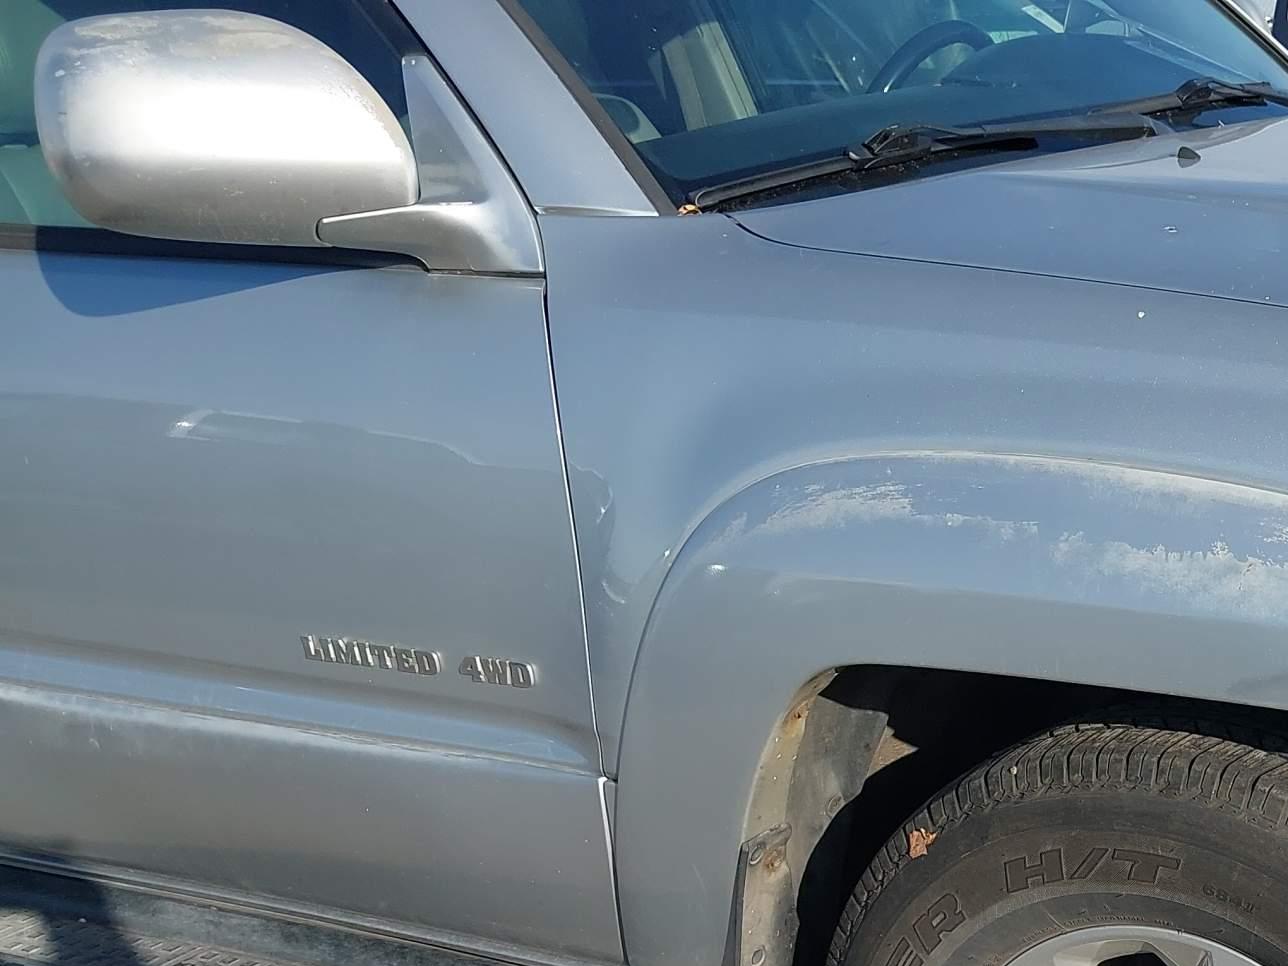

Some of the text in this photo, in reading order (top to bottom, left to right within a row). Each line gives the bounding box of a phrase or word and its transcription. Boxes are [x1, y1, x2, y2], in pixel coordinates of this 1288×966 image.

[300, 634, 538, 689] LIMITED 4WD
[1004, 847, 1183, 894] H/T
